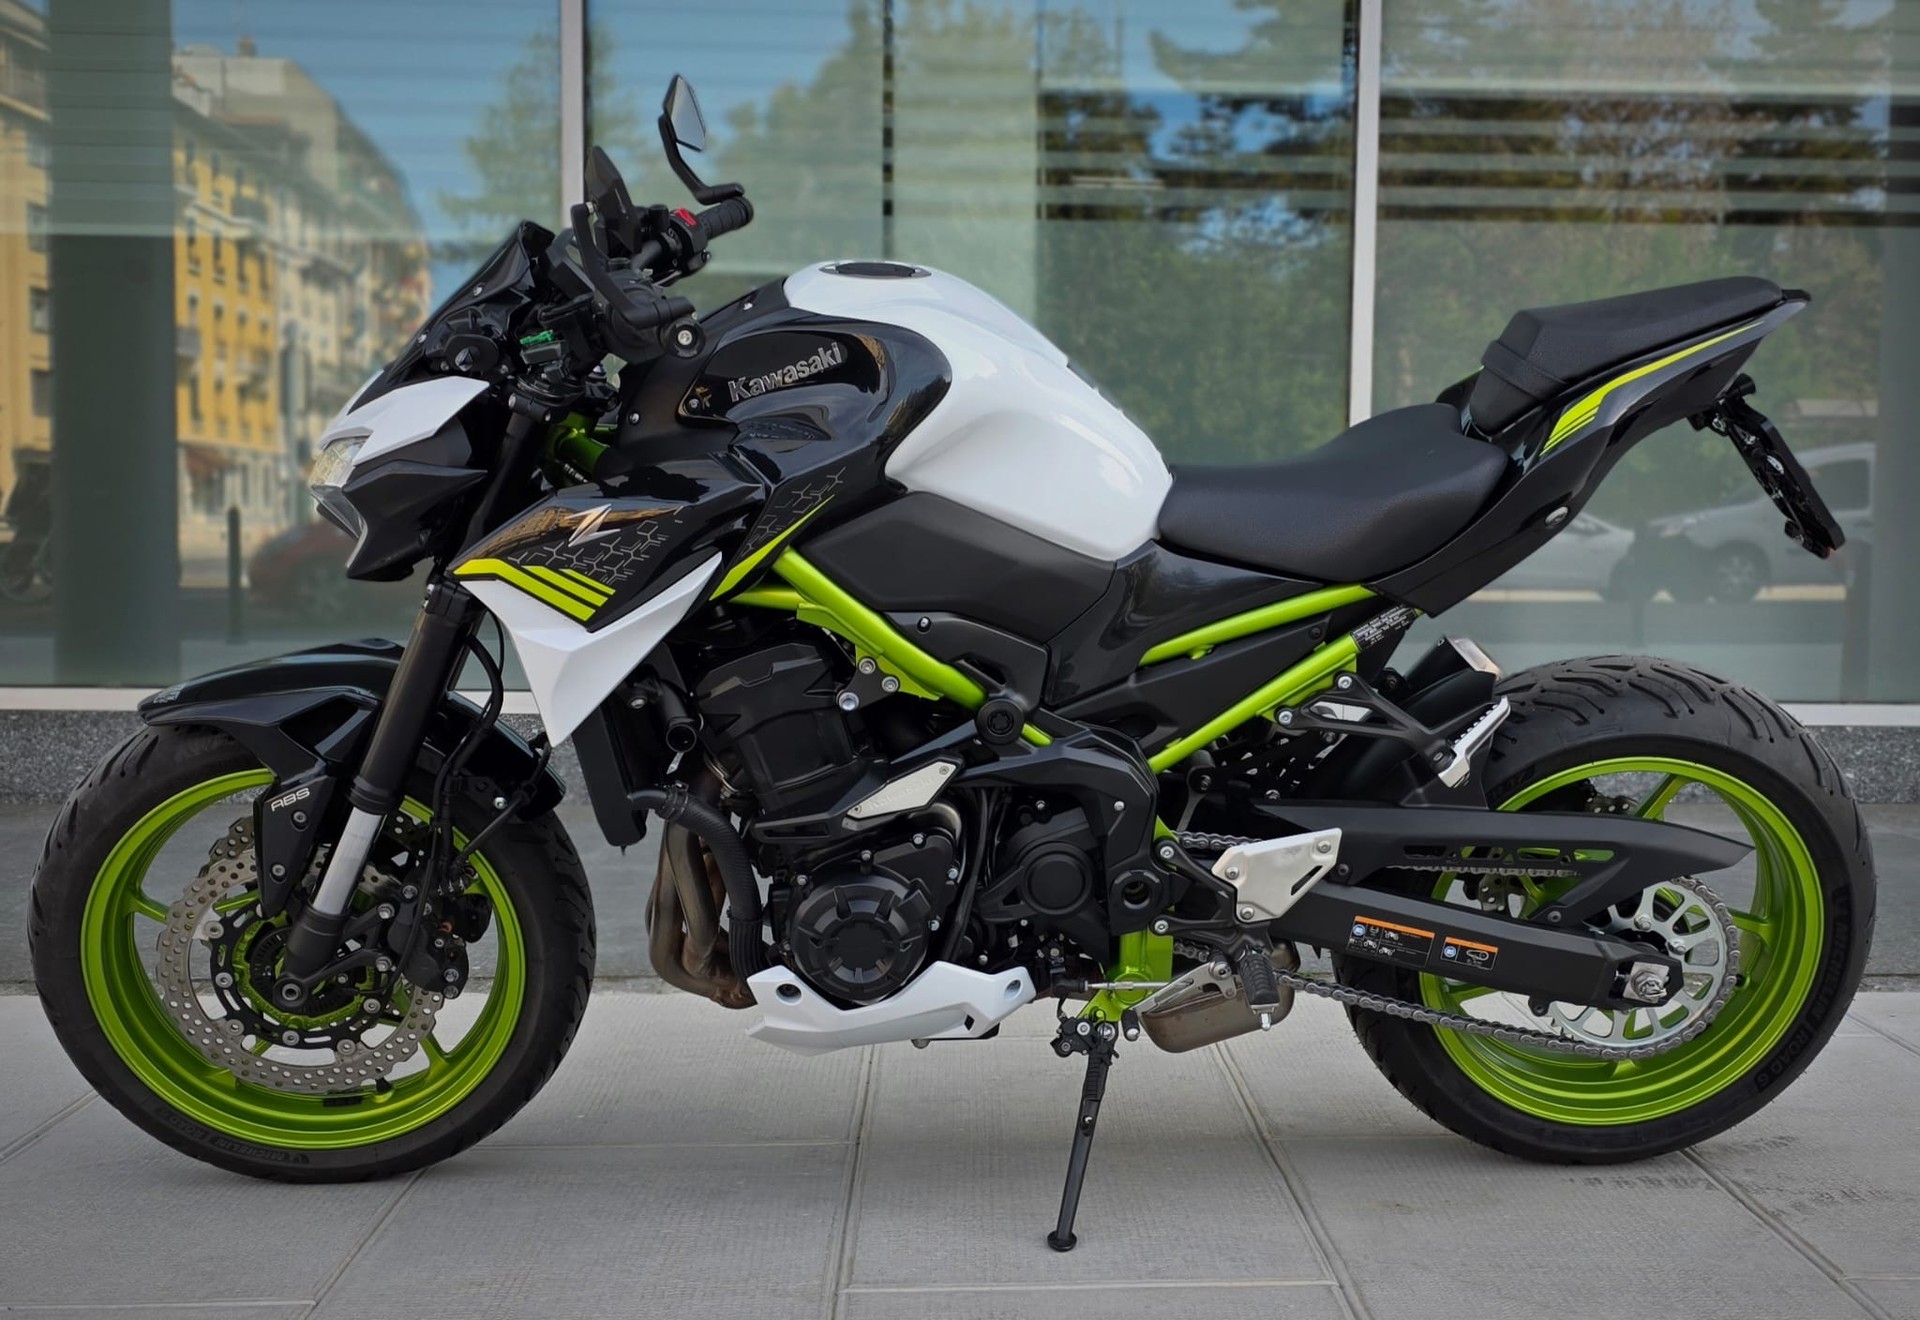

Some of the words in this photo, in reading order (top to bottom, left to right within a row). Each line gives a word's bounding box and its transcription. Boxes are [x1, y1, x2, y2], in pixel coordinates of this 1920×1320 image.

[728, 341, 843, 402] Kawasaki
[271, 787, 310, 812] ABS
[1812, 920, 1849, 1022] MICHELIN
[1771, 1028, 1810, 1075] ROAD
[169, 1116, 205, 1139] ROAD
[215, 1138, 286, 1161] MICHELIN
